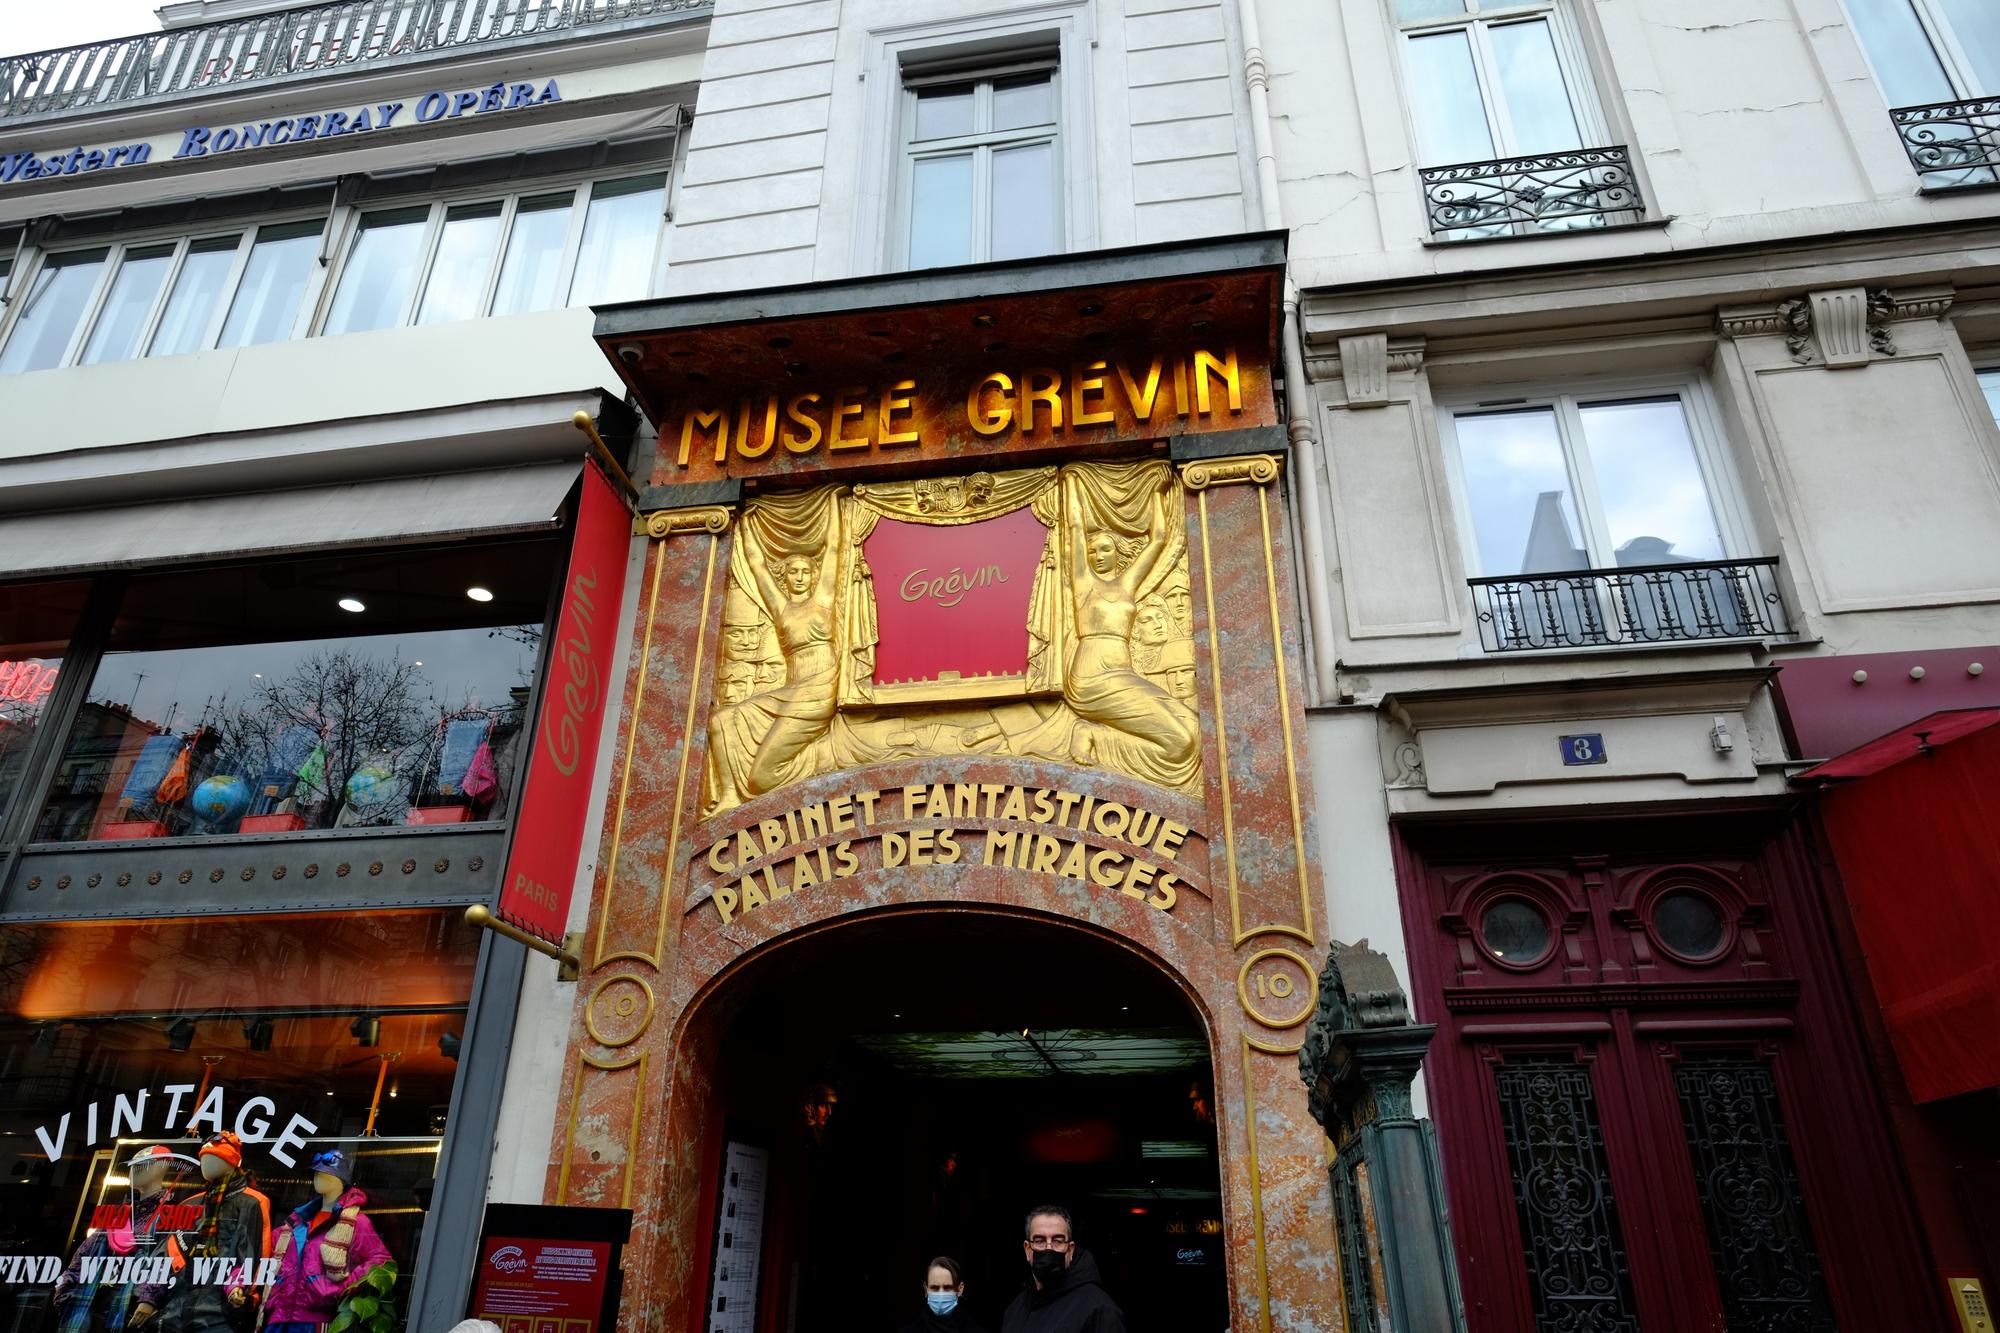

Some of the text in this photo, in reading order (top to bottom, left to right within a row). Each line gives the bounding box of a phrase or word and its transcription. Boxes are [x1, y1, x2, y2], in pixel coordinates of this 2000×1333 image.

[0, 78, 562, 182] Western RONCERAY OPÉRA
[678, 347, 1242, 469] MUSEE GREVIN
[708, 783, 1189, 875] CABINET FANTASTIQUE
[514, 873, 558, 913] PARIS
[711, 829, 1180, 924] PALAIS DES MIRAGES
[1256, 973, 1293, 998] 10
[34, 1084, 318, 1168] VINTAGE
[89, 1204, 205, 1231] KILO SHOP
[0, 1256, 278, 1289] FIND, WEIGH, WEAR
